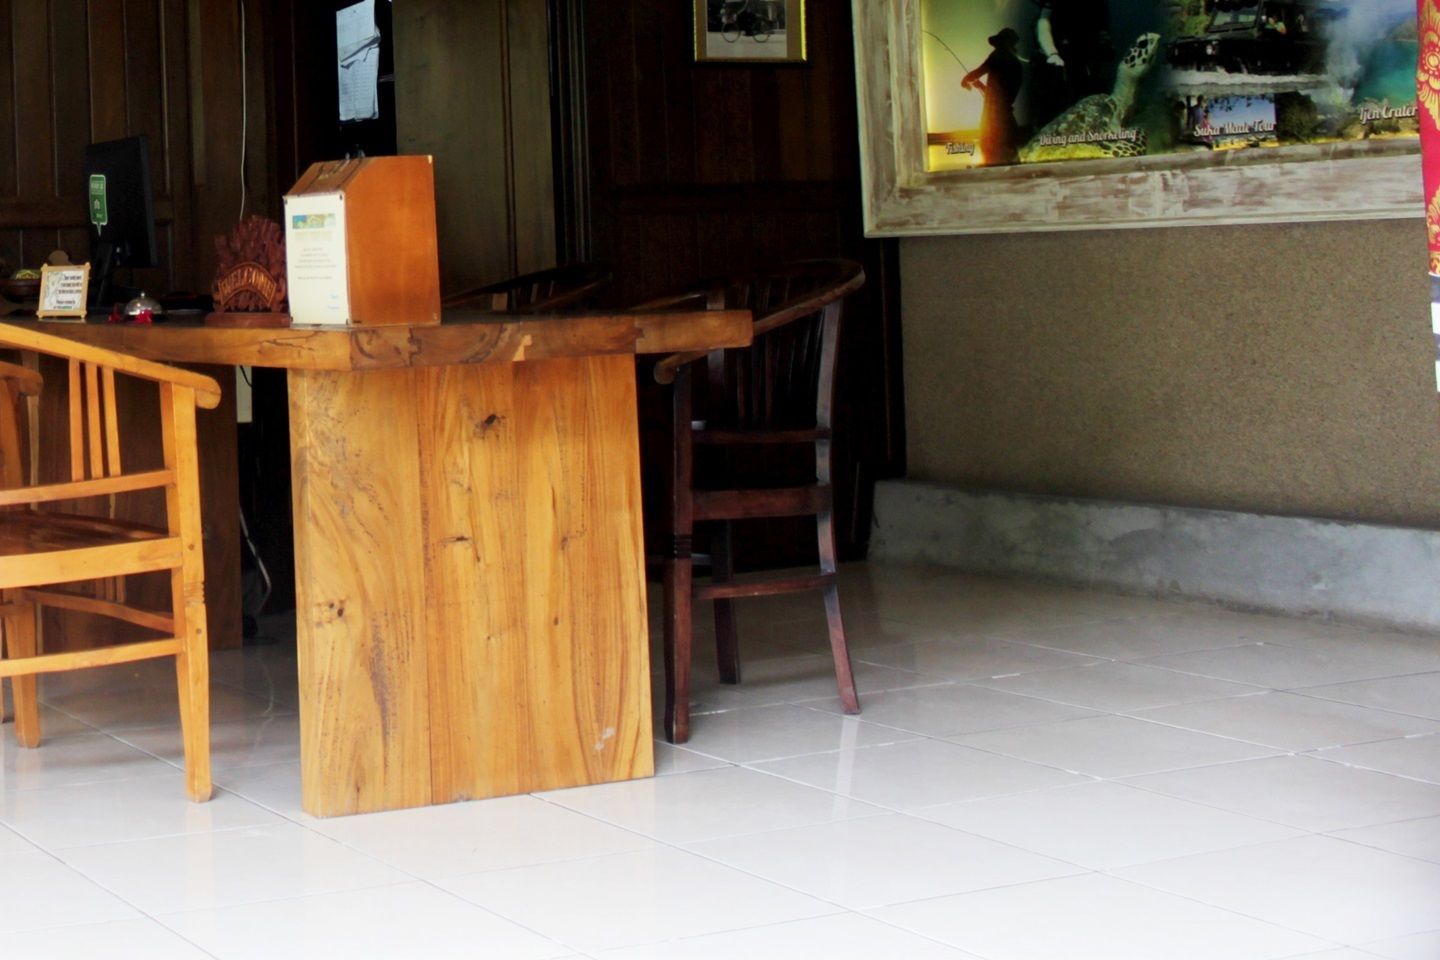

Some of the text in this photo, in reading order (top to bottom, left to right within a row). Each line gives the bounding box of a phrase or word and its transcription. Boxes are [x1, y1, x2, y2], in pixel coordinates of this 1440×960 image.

[1382, 105, 1418, 119] Crater
[1193, 119, 1277, 137] Suka Made Tour
[1040, 128, 1137, 147] Diving and Snorkeling
[945, 142, 975, 156] Fishing
